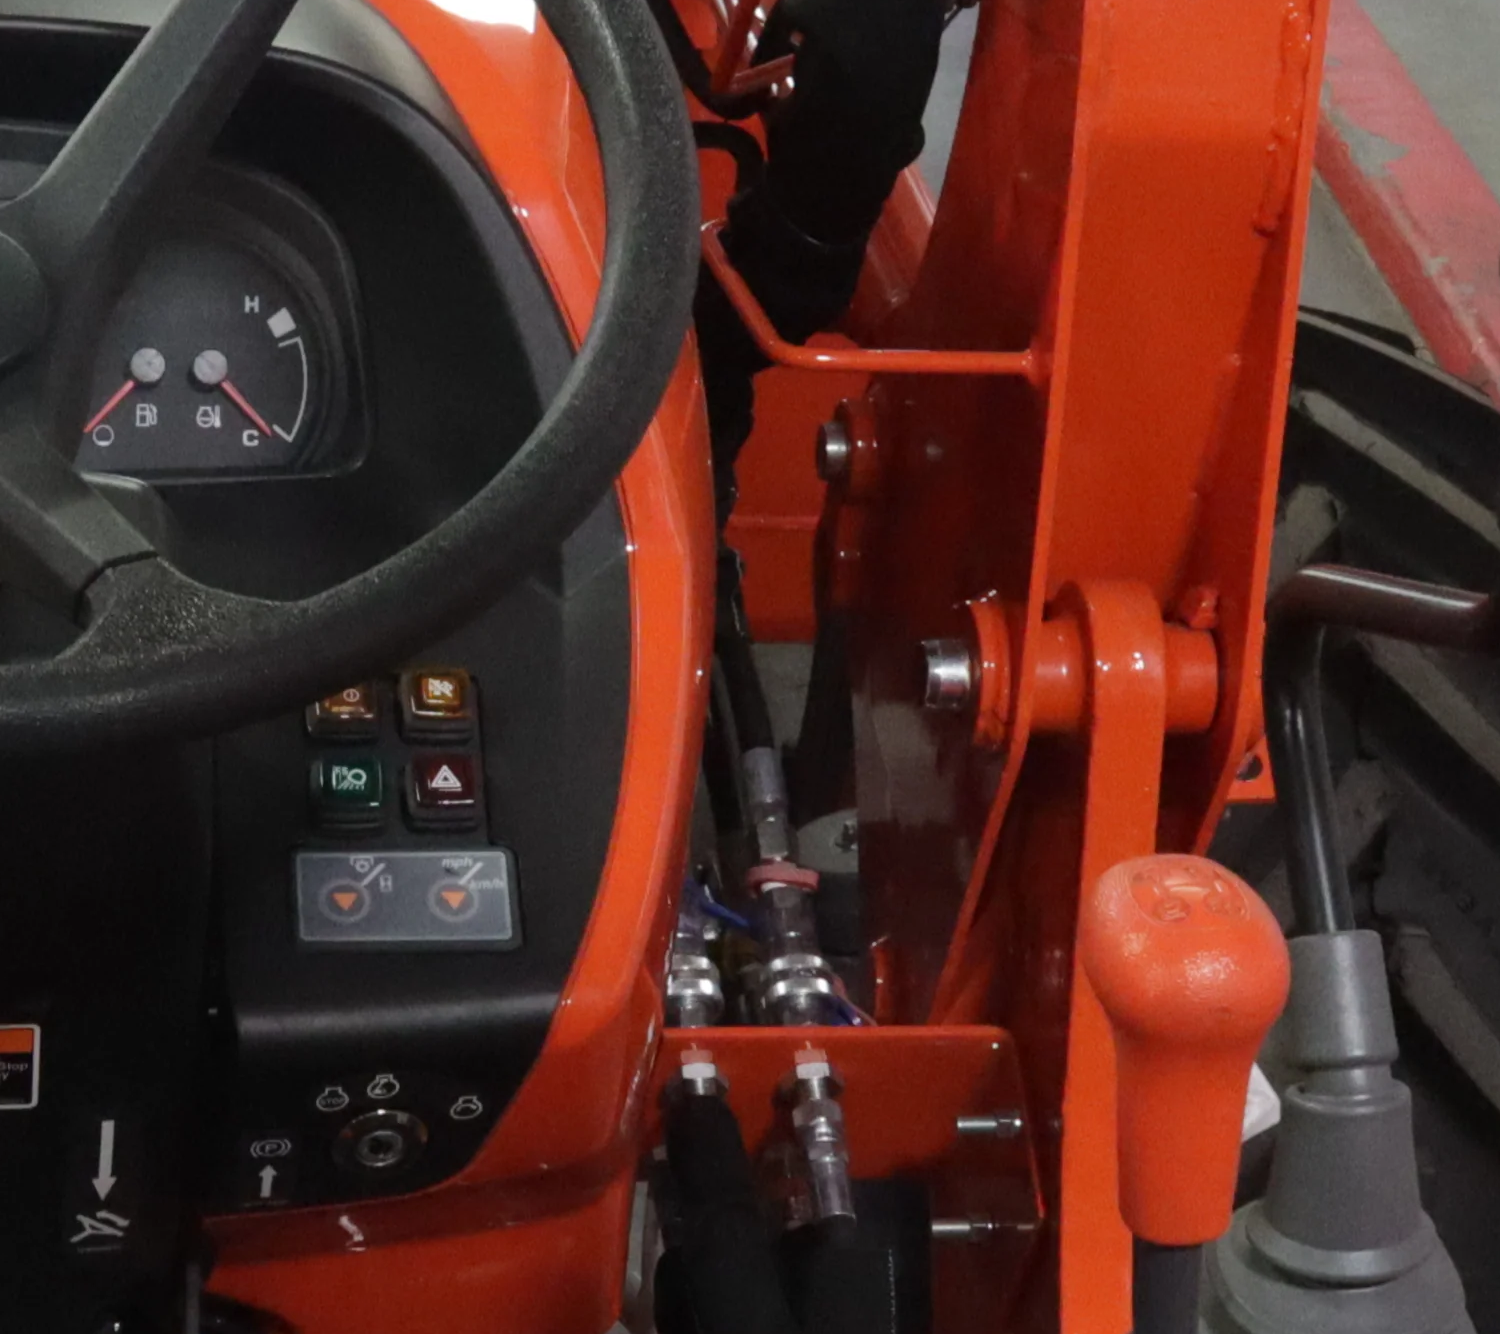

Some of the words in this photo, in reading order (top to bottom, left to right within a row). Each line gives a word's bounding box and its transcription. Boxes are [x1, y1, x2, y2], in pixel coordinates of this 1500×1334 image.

[244, 295, 259, 313] H
[242, 430, 259, 447] C
[442, 857, 473, 868] mph
[468, 878, 505, 890] km/h
[320, 1097, 345, 1107] STOP
